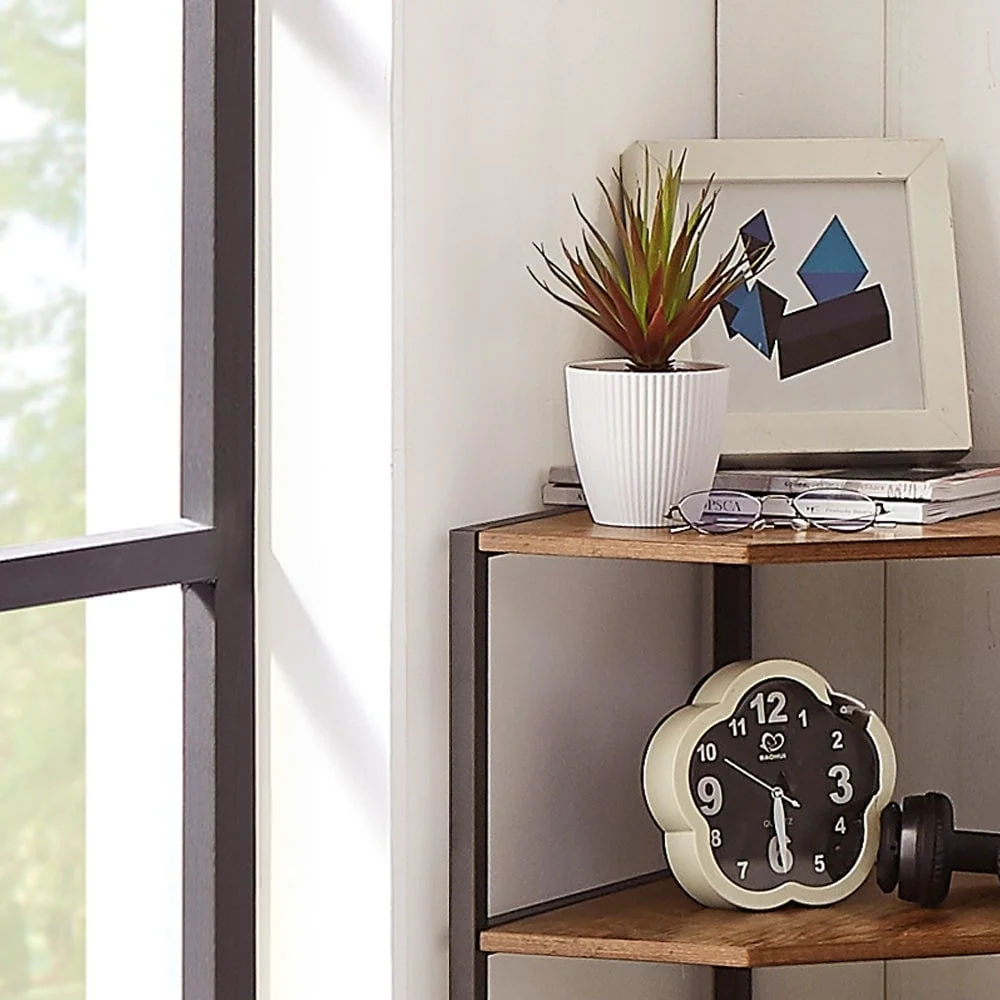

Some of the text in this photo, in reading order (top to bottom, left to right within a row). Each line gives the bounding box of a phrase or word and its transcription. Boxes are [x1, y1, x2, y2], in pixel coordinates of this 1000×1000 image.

[750, 692, 788, 725] 12
[799, 709, 808, 727] 1
[728, 717, 747, 736] 11
[832, 731, 844, 749] 2
[697, 743, 717, 761] 10
[828, 764, 853, 805] 3
[697, 776, 723, 816] 9
[834, 816, 846, 835] 4
[711, 829, 722, 847] 8
[768, 835, 794, 874] 6
[814, 854, 826, 873] 5
[736, 861, 748, 880] 7
